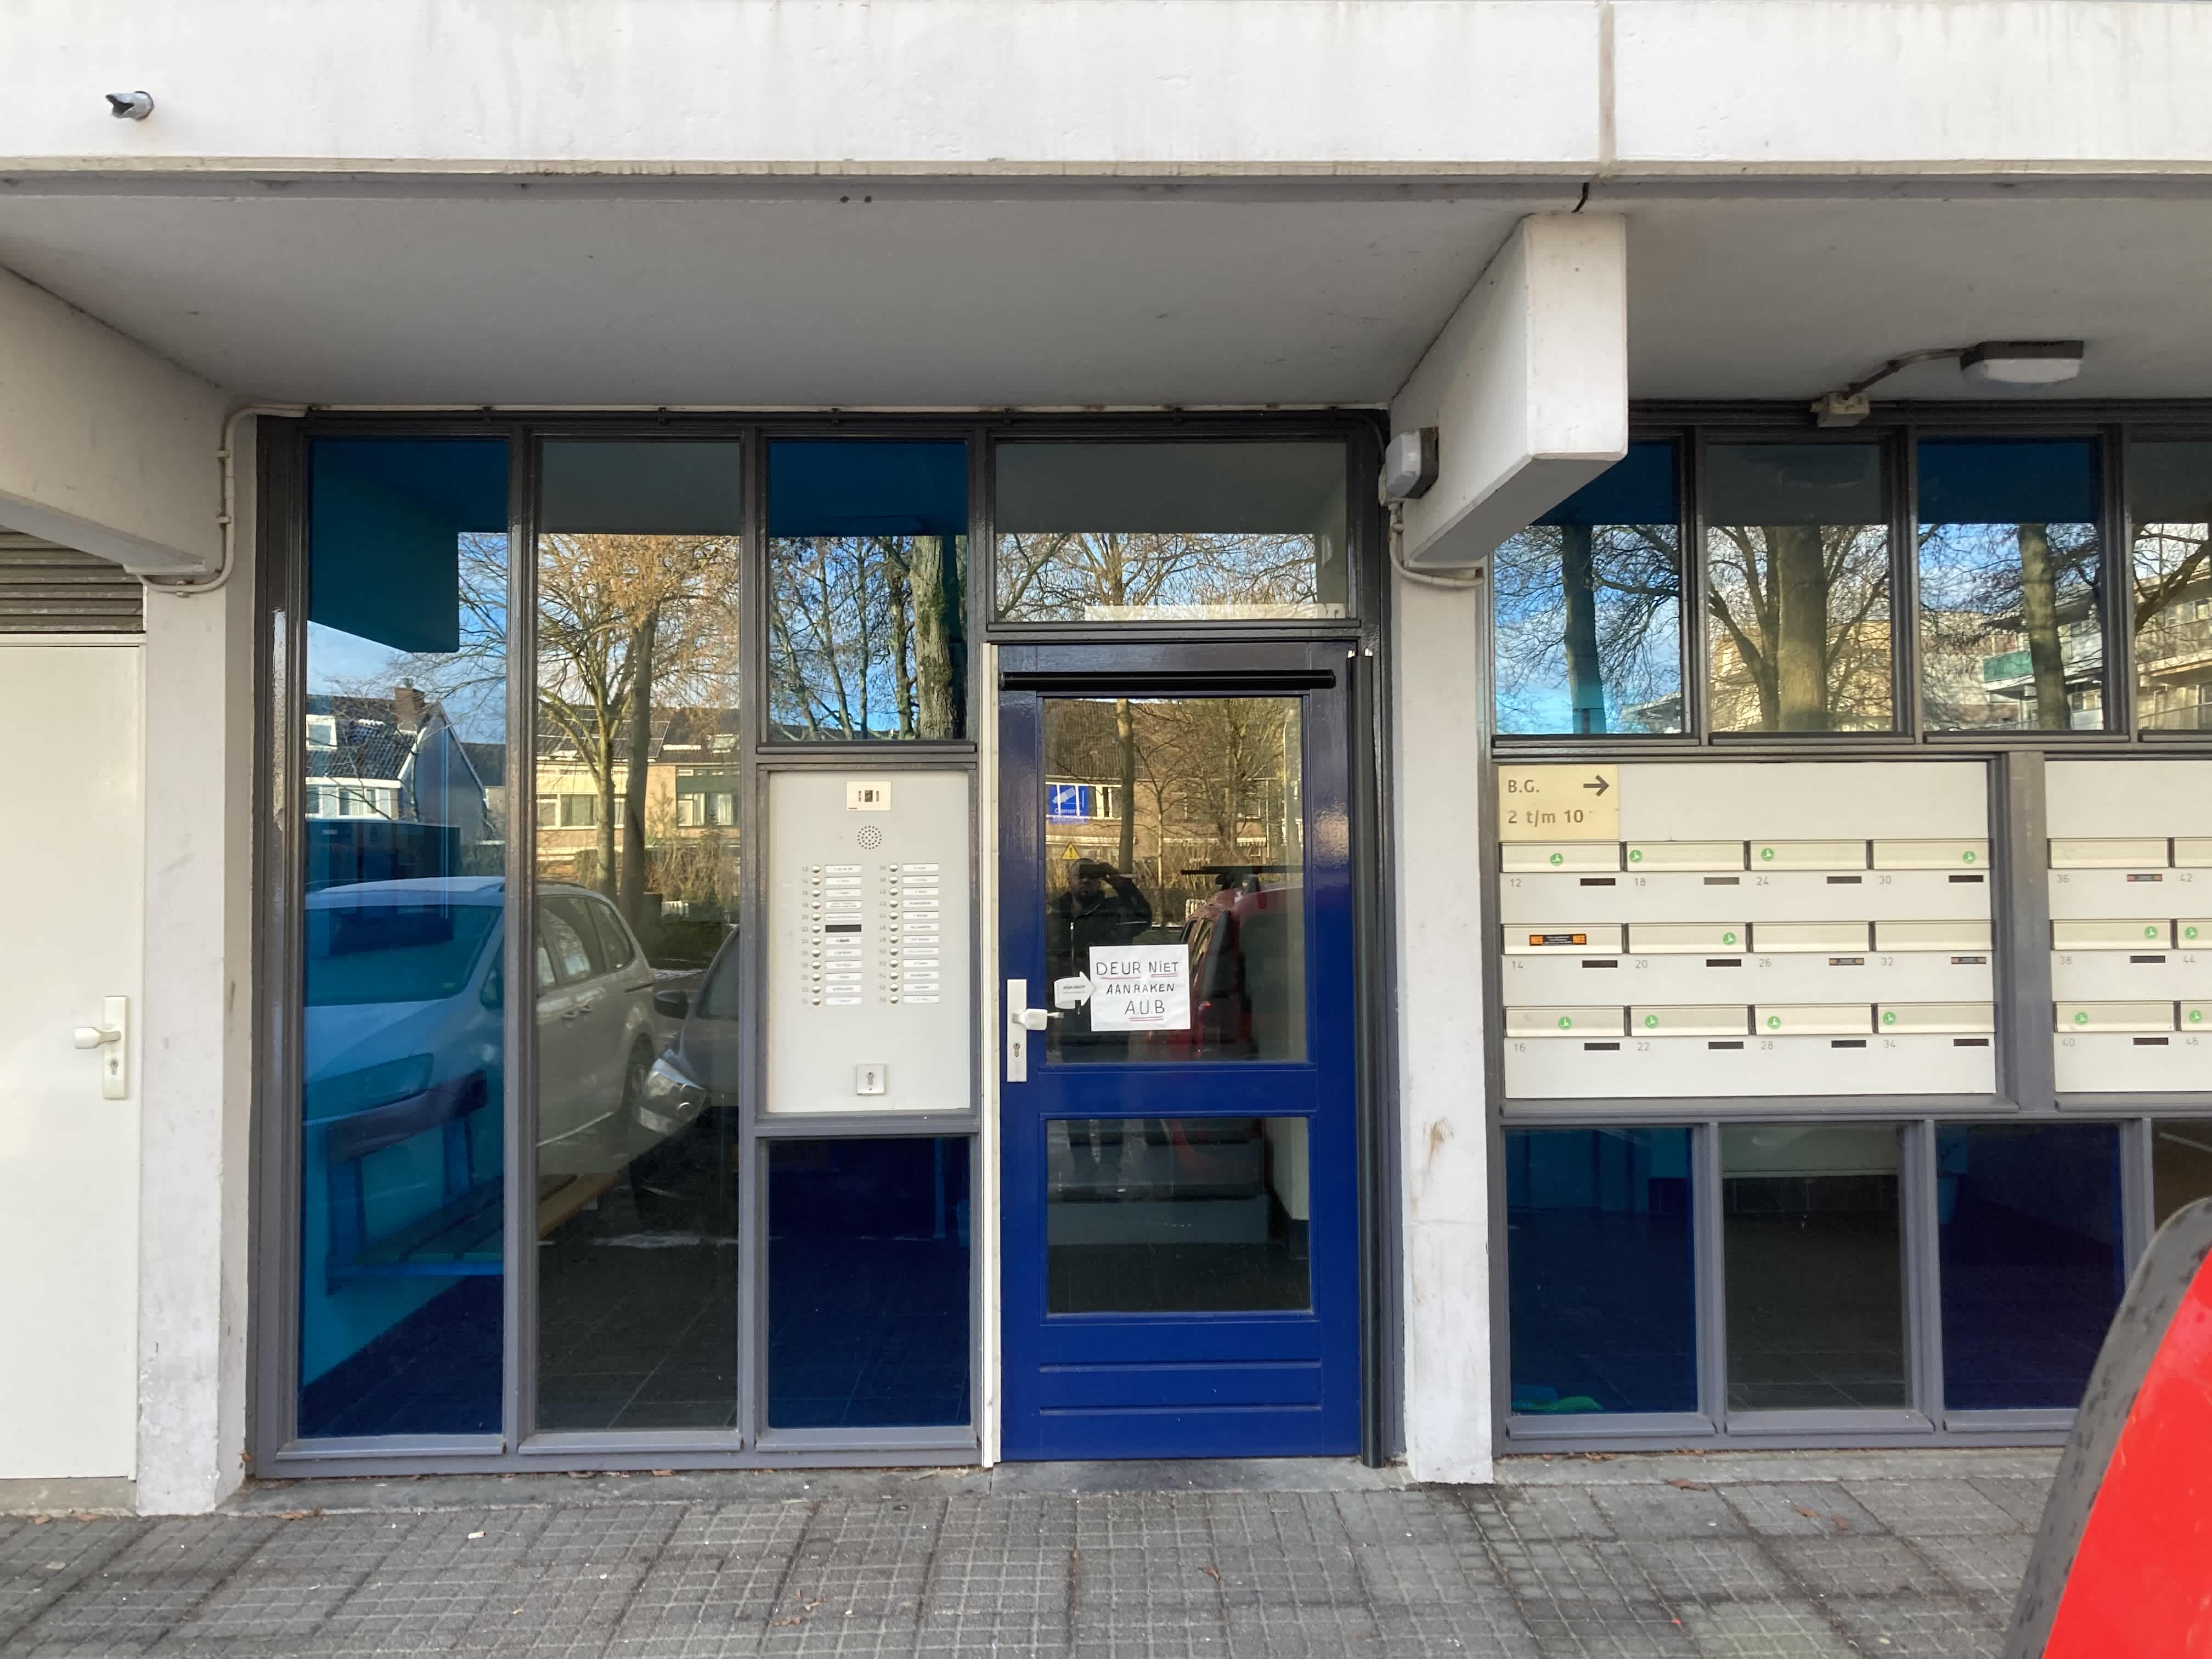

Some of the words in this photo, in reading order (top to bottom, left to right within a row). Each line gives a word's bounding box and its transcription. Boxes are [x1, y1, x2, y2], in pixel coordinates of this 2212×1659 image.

[1508, 779, 1540, 793] B.G.
[1508, 810, 1517, 824] 2
[1526, 809, 1556, 827] t/m
[1564, 809, 1584, 823] 10
[1635, 878, 1646, 886] 18
[1757, 877, 1769, 885] 24
[1880, 876, 1891, 884] 30
[2057, 874, 2069, 883] 36
[2180, 873, 2192, 882] 42
[1510, 878, 1521, 887] 12
[1636, 960, 1647, 968] 20
[1760, 958, 1771, 967] 26
[1882, 957, 1893, 966] 32
[2059, 956, 2072, 964] 38
[1096, 961, 1141, 975] DEUR
[1106, 984, 1175, 995] AANRAKEN
[1125, 1000, 1165, 1015] A.U.B
[1638, 1042, 1650, 1051] 22
[1762, 1041, 1773, 1049] 28
[2063, 1038, 2075, 1047] 40
[1514, 1043, 1525, 1052] 16
